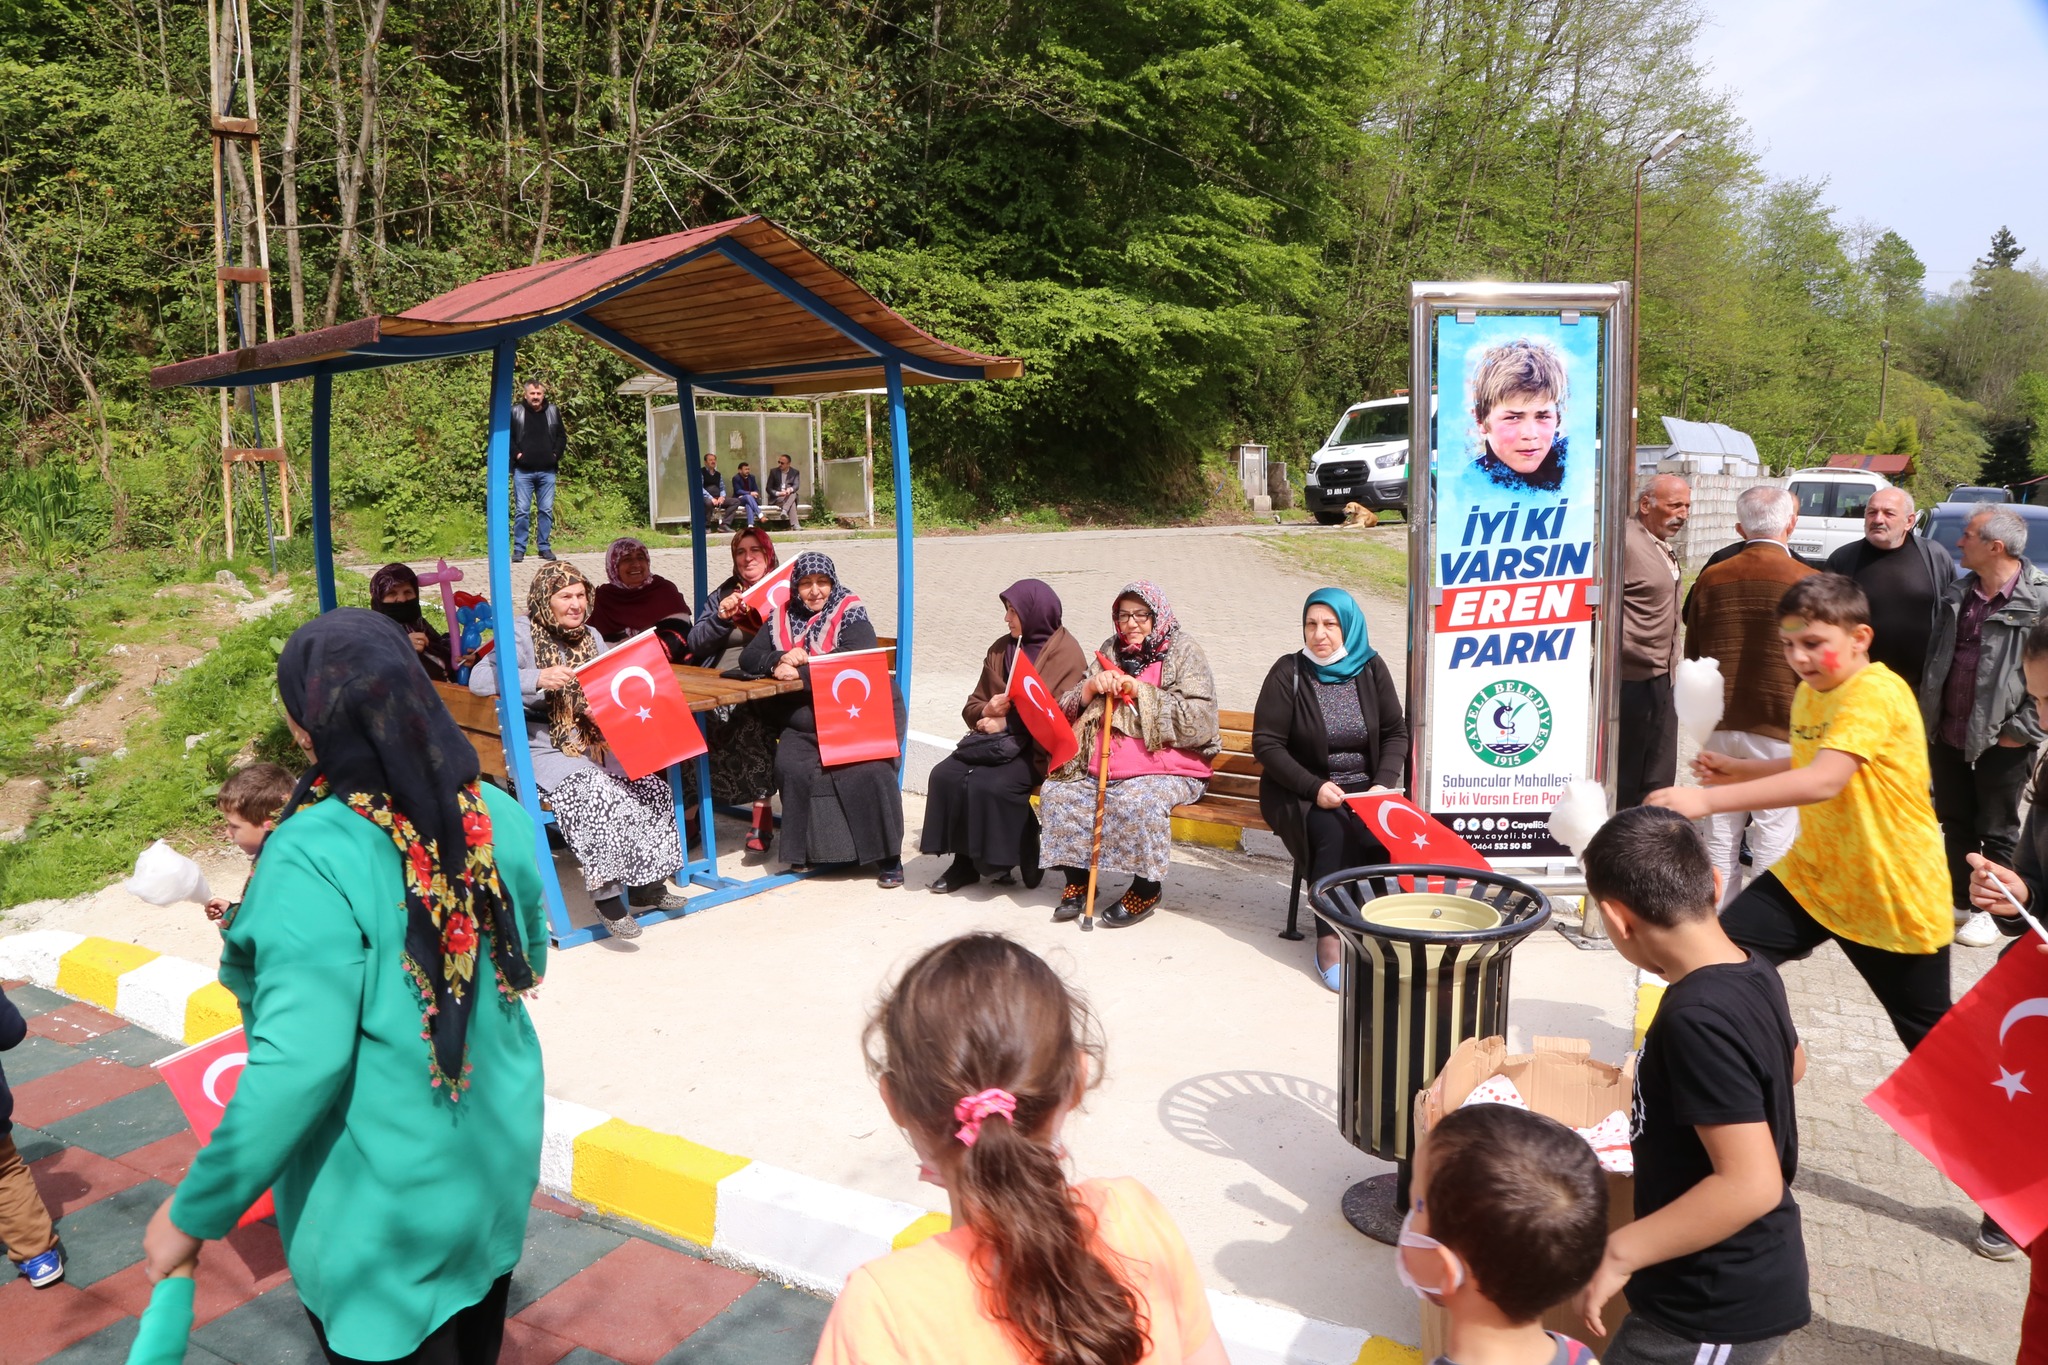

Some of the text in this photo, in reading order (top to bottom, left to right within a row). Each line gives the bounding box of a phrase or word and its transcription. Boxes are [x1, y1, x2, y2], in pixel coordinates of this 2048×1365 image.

[1461, 498, 1569, 546] İYİ Kİ
[1440, 541, 1592, 585] VARSIN
[1448, 583, 1576, 627] EREN
[1448, 627, 1576, 670] PARKI
[1493, 681, 1550, 755] BELEDİYESİ
[1493, 755, 1521, 766] 1915
[1442, 774, 1512, 788] Sabuncular
[1441, 790, 1565, 808] İyi ki Varsın Eren Par
[1511, 820, 1548, 831] CayeliBe
[1471, 842, 1532, 850] 0464 532 50 85
